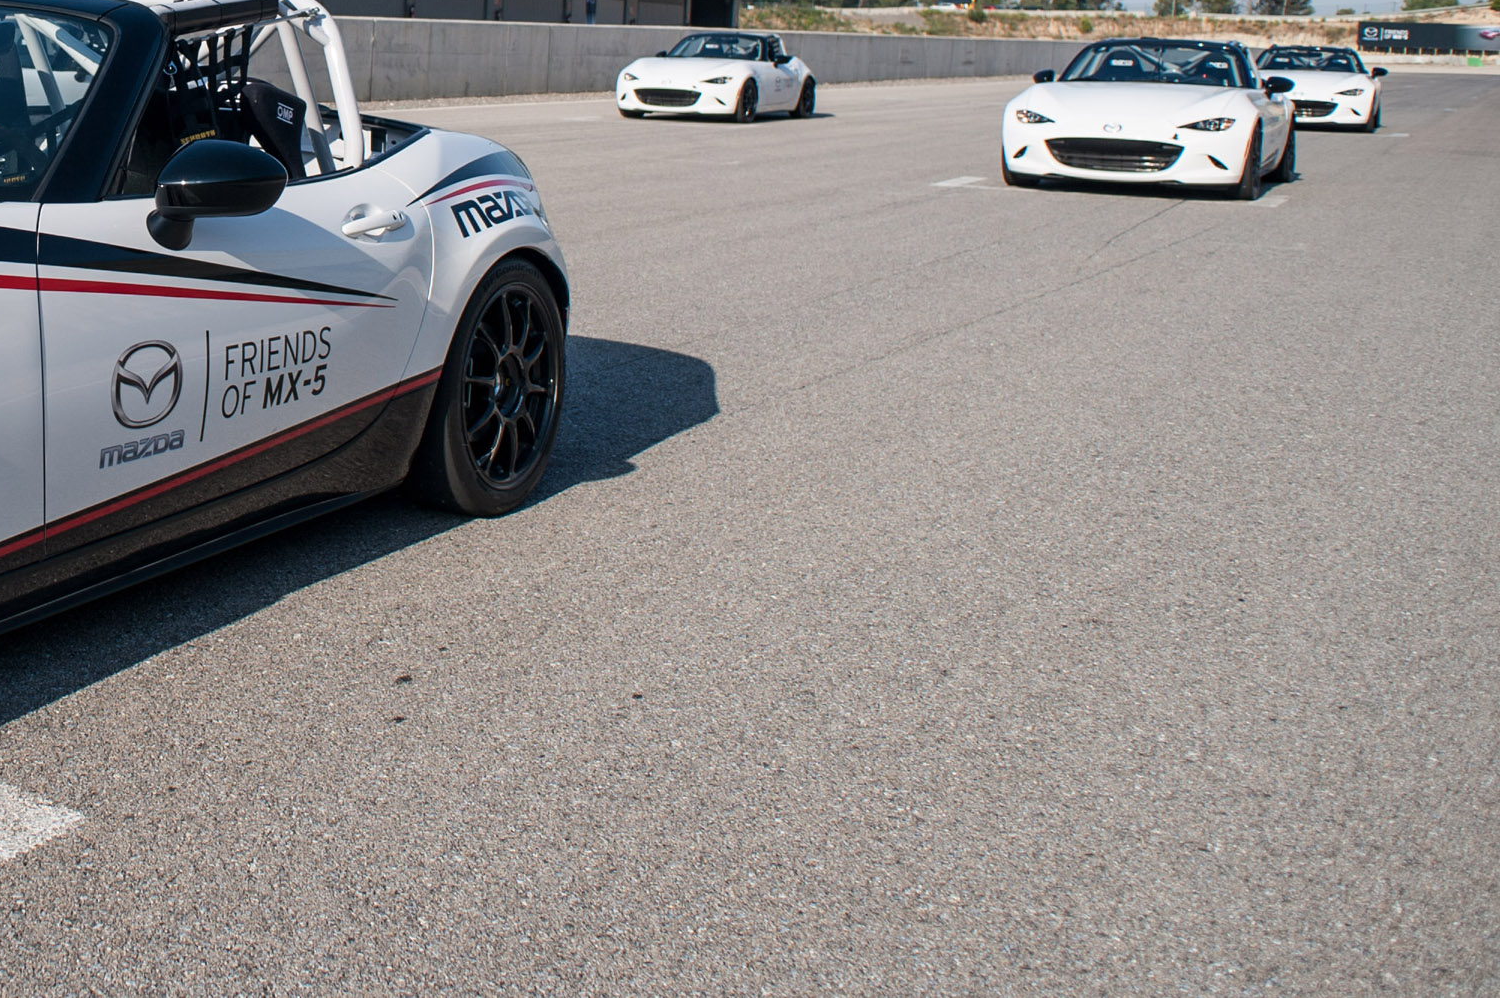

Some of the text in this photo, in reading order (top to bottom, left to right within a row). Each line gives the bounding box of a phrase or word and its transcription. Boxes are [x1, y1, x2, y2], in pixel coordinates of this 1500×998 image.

[277, 105, 293, 121] OMP
[451, 190, 534, 238] mazd
[224, 325, 332, 381] FRIENDS
[221, 363, 328, 419] OF MX-5
[98, 428, 186, 470] mazda
